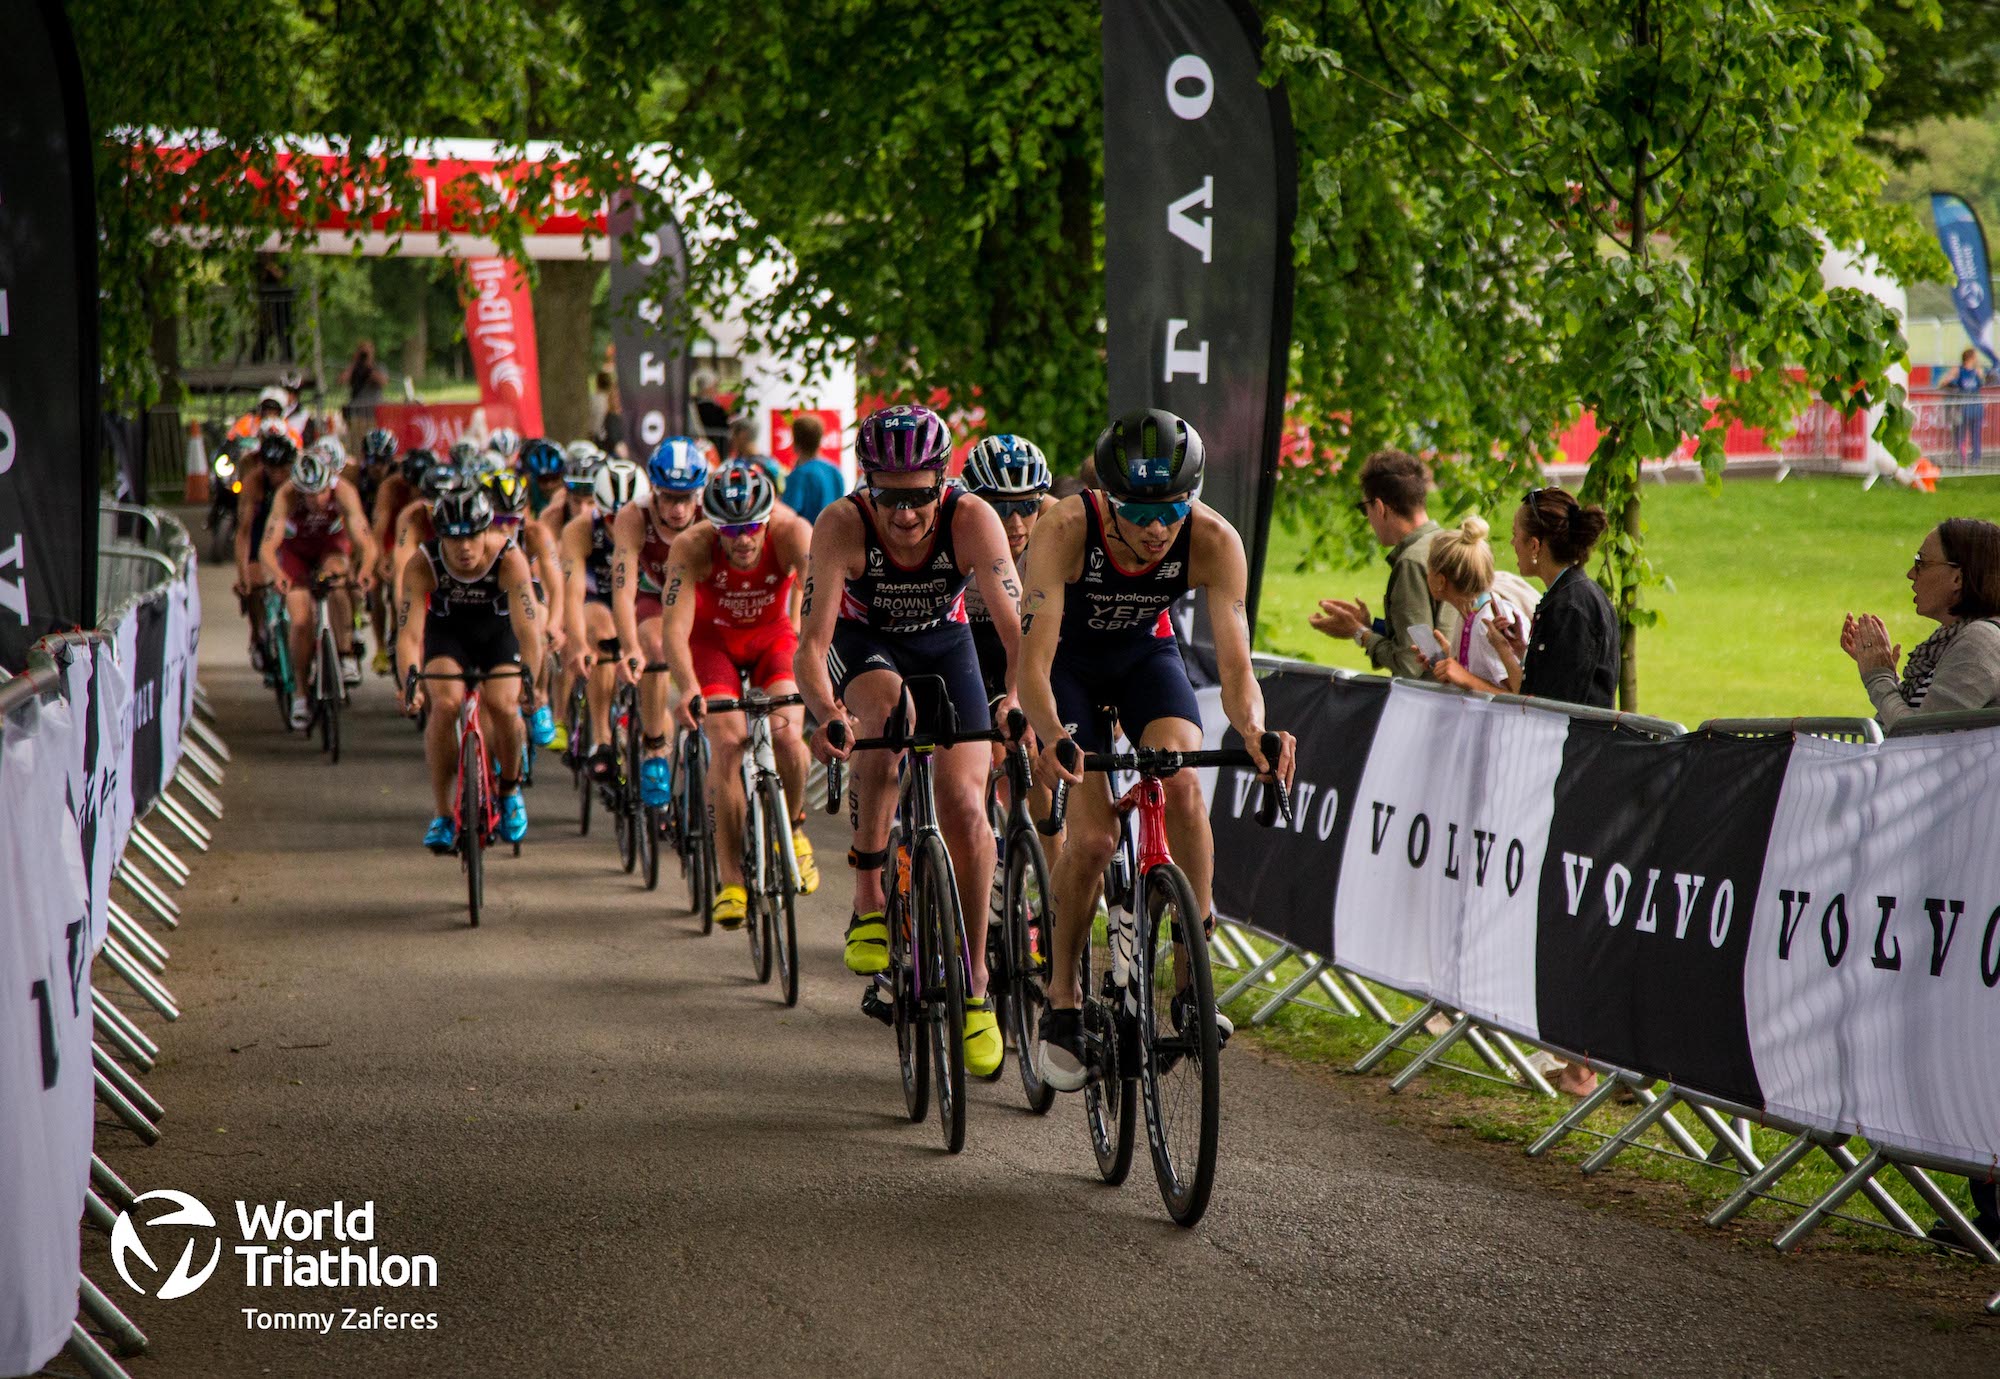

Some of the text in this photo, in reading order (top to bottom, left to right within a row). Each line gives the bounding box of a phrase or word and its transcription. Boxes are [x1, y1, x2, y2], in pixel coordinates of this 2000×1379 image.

[884, 418, 899, 428] 54
[1003, 453, 1011, 464] 8
[1138, 465, 1147, 478] 4
[665, 578, 682, 606] 28
[876, 582, 934, 591] BAHRAIN
[873, 593, 951, 611] BROWNLEE
[1086, 592, 1170, 603] new balance
[731, 608, 762, 618] SUI
[890, 609, 934, 618] GBR
[1092, 604, 1157, 619] YEE
[1087, 618, 1139, 630] GBR
[1371, 800, 1525, 898] VOLVO
[1562, 851, 1735, 949] VOLVO
